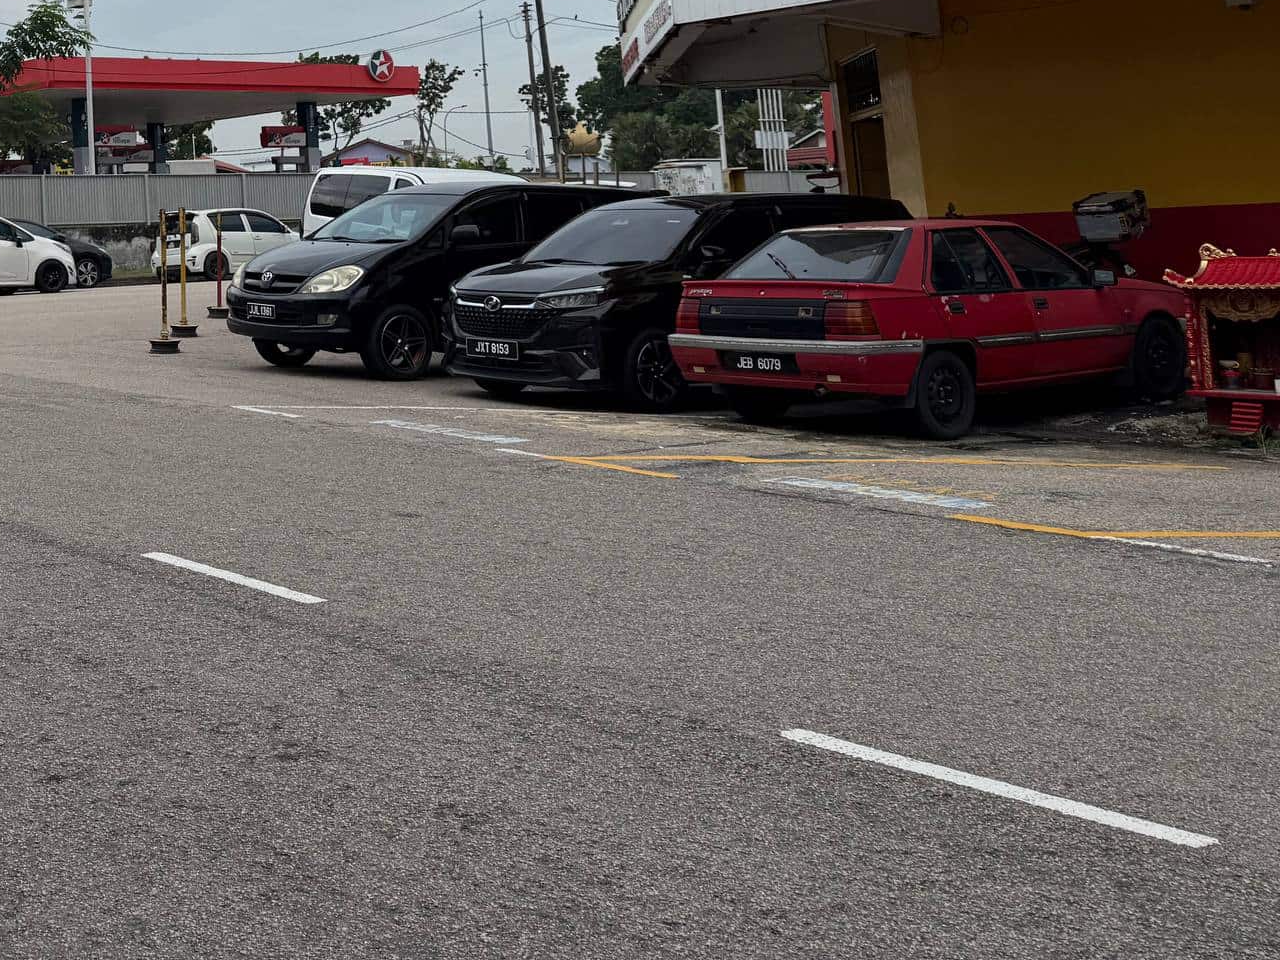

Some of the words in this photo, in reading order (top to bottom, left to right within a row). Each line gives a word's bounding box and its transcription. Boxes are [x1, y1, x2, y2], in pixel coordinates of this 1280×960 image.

[475, 342, 490, 353] JXT
[491, 343, 509, 354] 8153
[737, 357, 753, 369] JEB
[757, 357, 781, 370] 6079
